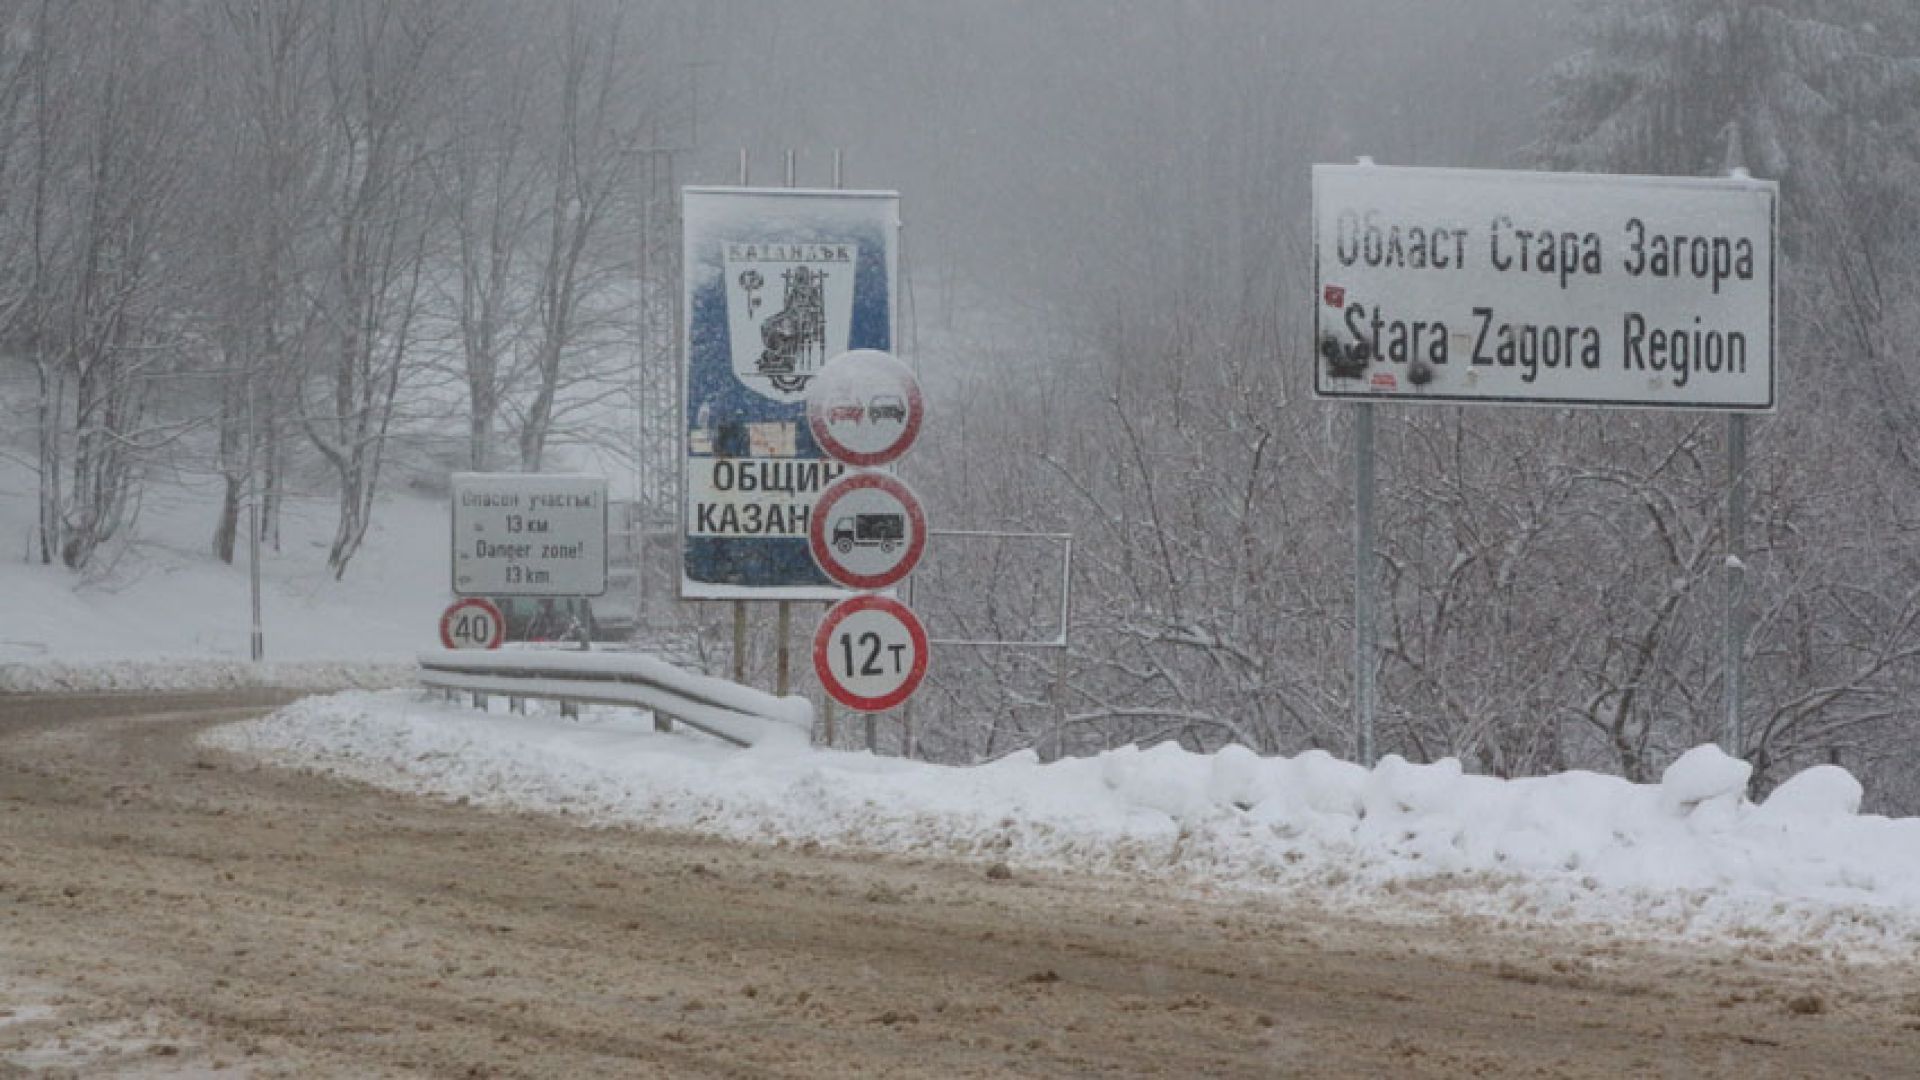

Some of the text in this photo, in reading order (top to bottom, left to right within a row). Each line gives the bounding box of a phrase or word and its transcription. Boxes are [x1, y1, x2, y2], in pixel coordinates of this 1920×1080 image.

[1337, 208, 1753, 294] Област Стара Загора
[1345, 302, 1746, 387] Stara Zagora Region
[713, 460, 844, 497] ОБЩИН
[506, 514, 523, 534] 13
[697, 503, 810, 534] КАЗАН
[476, 539, 583, 562] Danger zone!
[506, 566, 550, 584] 13 km
[455, 614, 488, 643] 40
